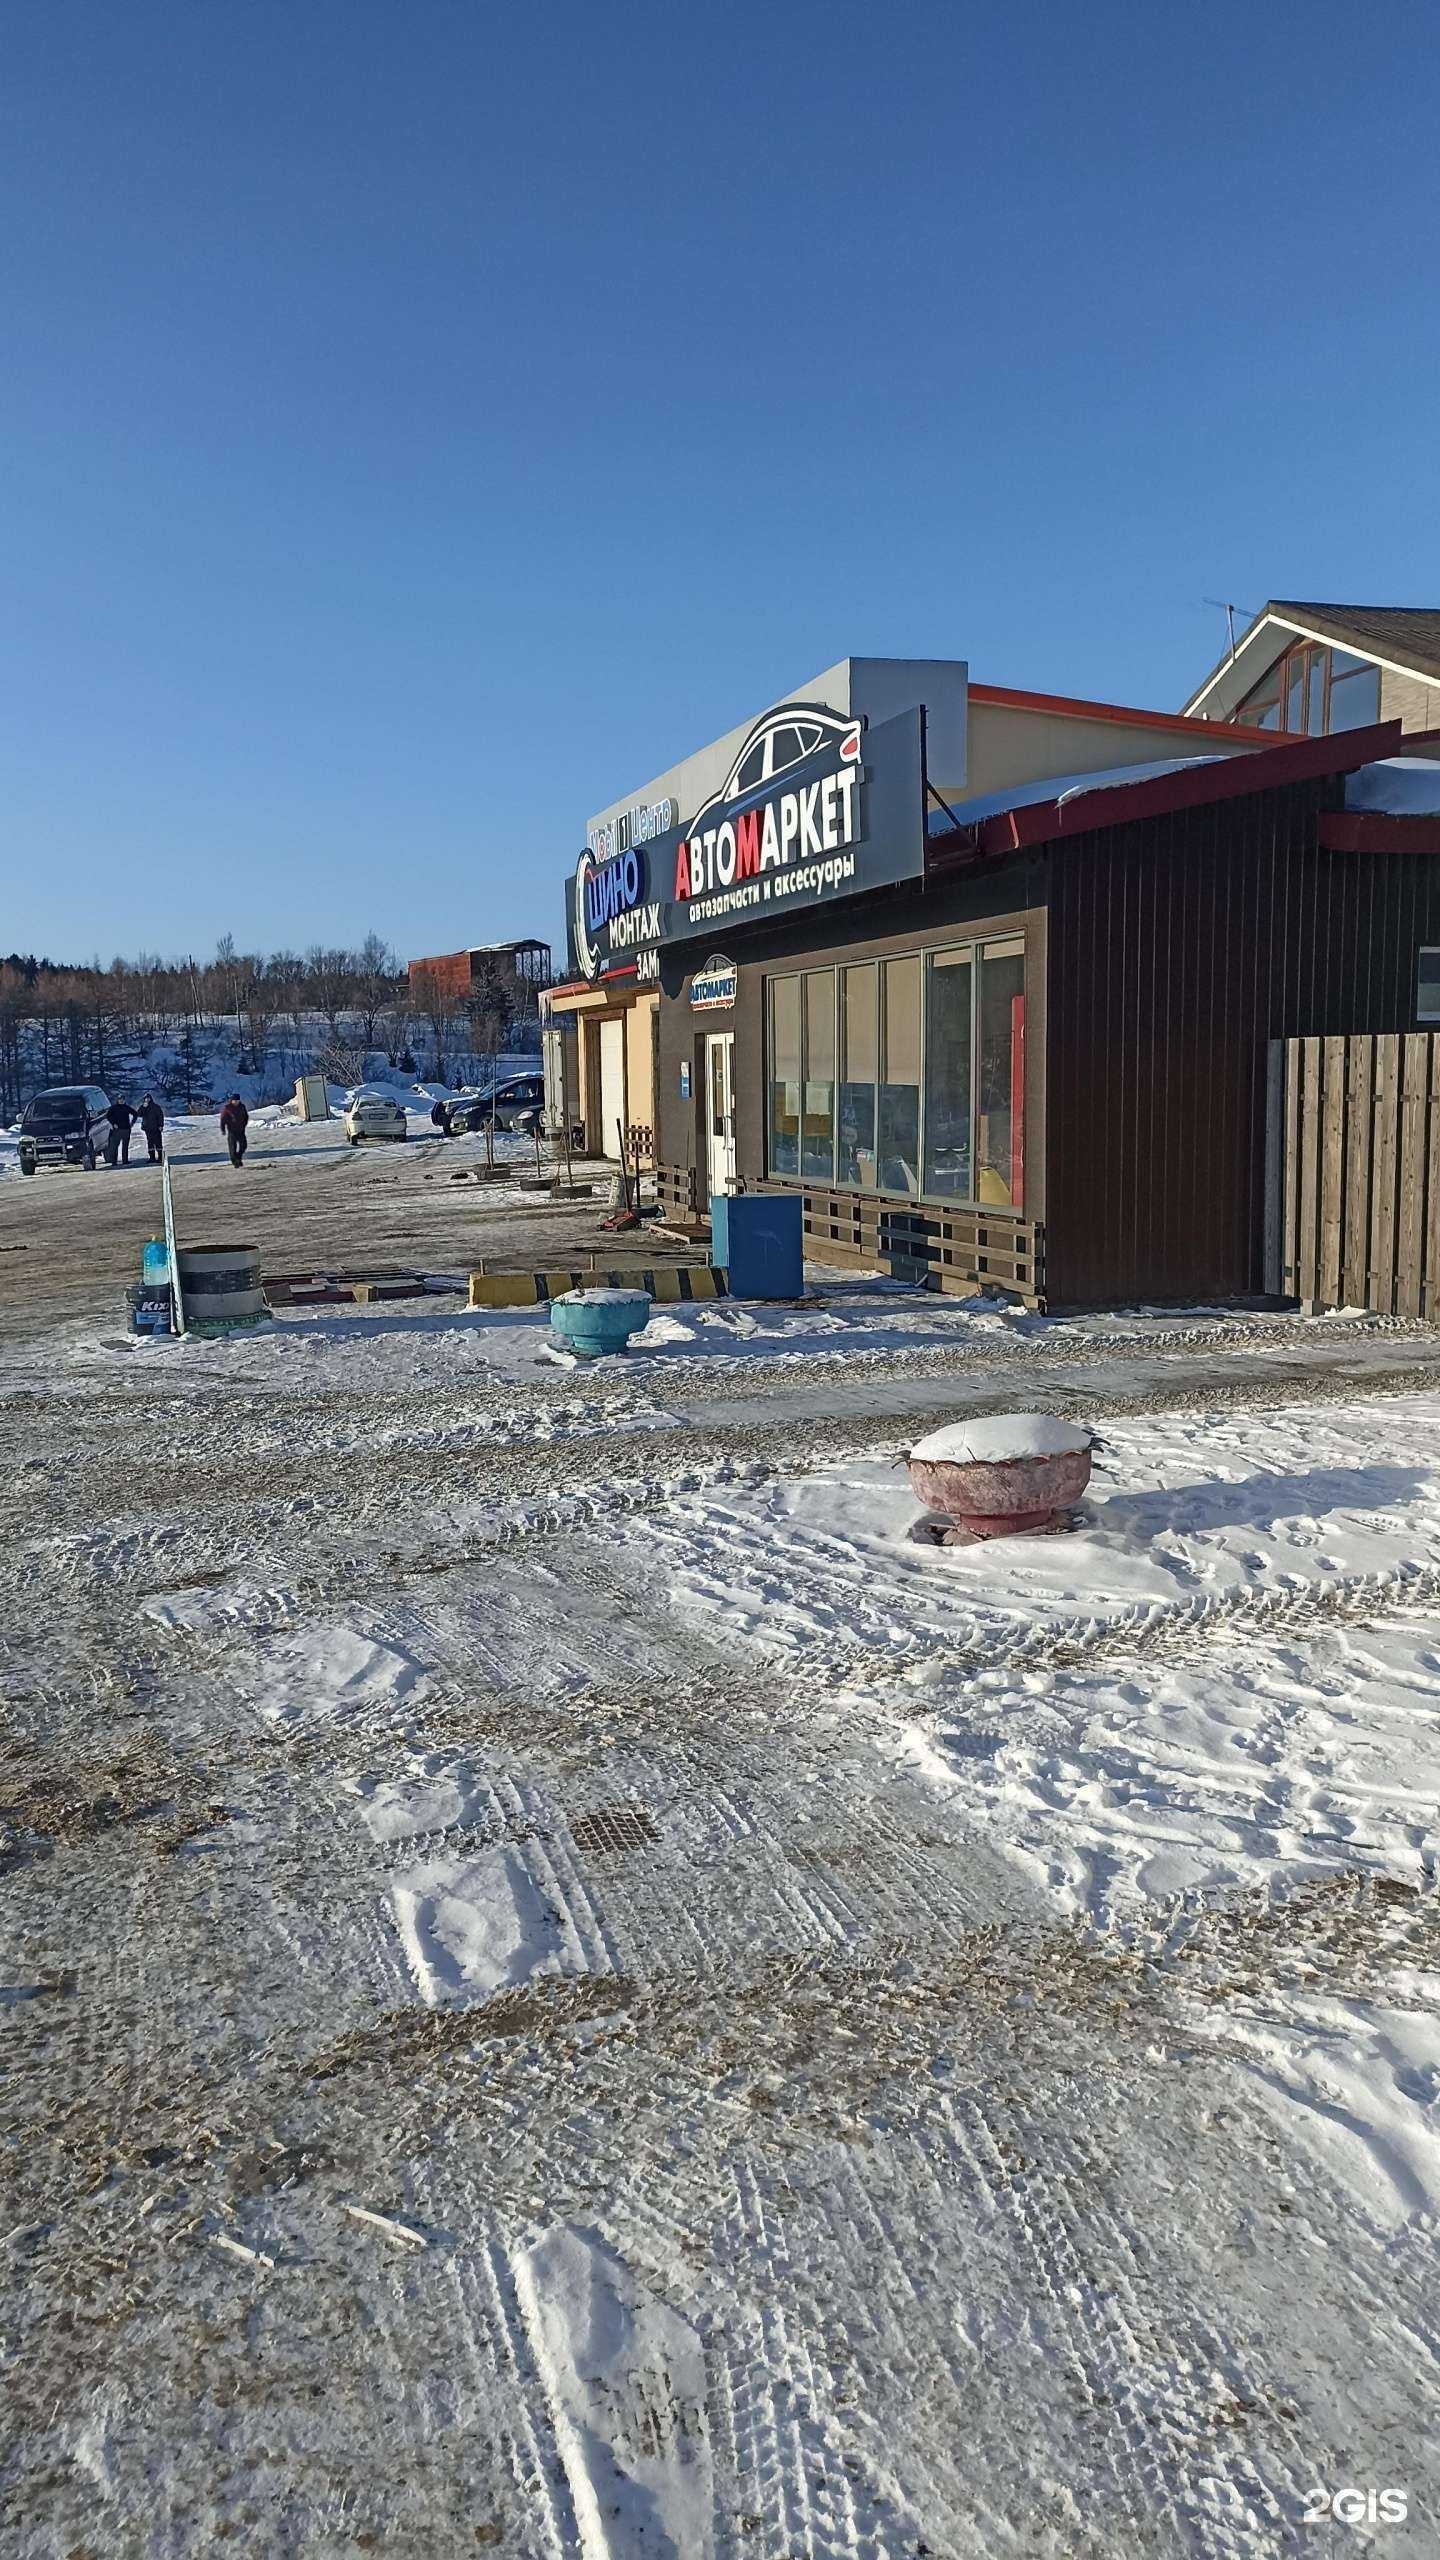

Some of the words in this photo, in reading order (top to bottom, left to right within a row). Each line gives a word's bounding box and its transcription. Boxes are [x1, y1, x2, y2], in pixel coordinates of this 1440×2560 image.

[631, 798, 672, 848] Центр
[675, 766, 856, 901] АВТОМАРКЕТ
[587, 849, 639, 932] ШИНО
[689, 883, 760, 923] автозапчасти
[763, 879, 771, 900] и
[774, 853, 855, 896] аксессуары
[609, 902, 661, 949] МОНТАЖ
[636, 948, 660, 981] ЗАМ
